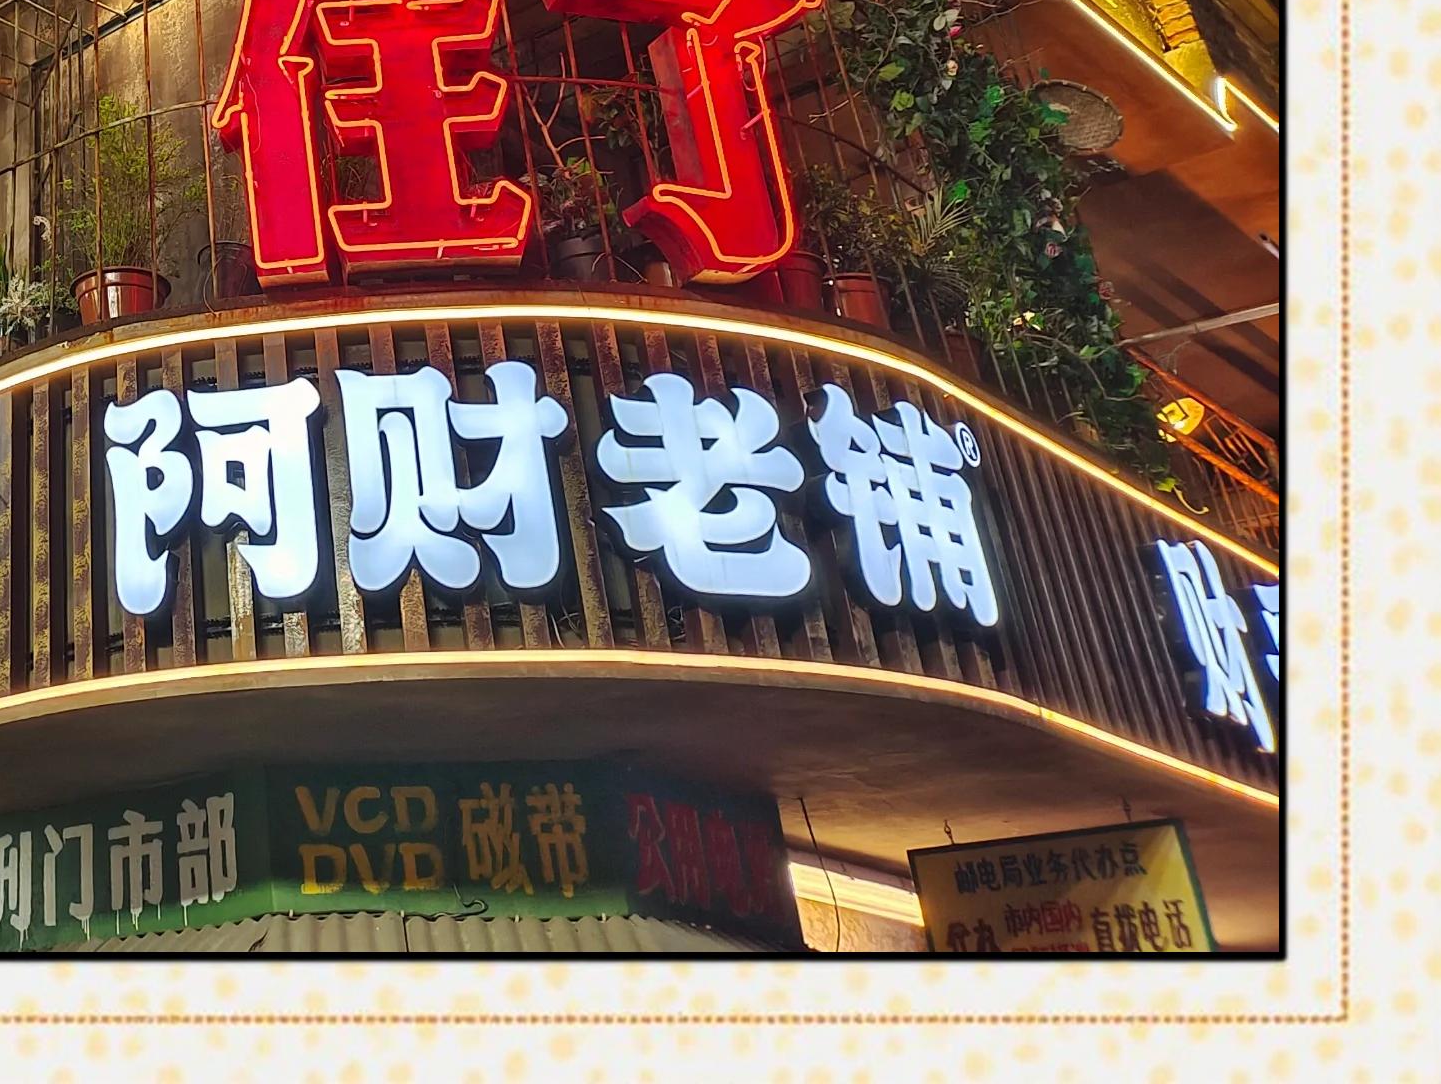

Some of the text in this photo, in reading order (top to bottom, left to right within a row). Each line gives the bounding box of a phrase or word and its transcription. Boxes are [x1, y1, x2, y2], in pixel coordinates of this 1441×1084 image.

[104, 360, 1001, 629] 阿财老铺
[294, 785, 439, 837] VCD
[298, 840, 446, 896] DVD
[459, 782, 589, 898] 磁带
[954, 839, 1147, 894] 邮电局业务代办点
